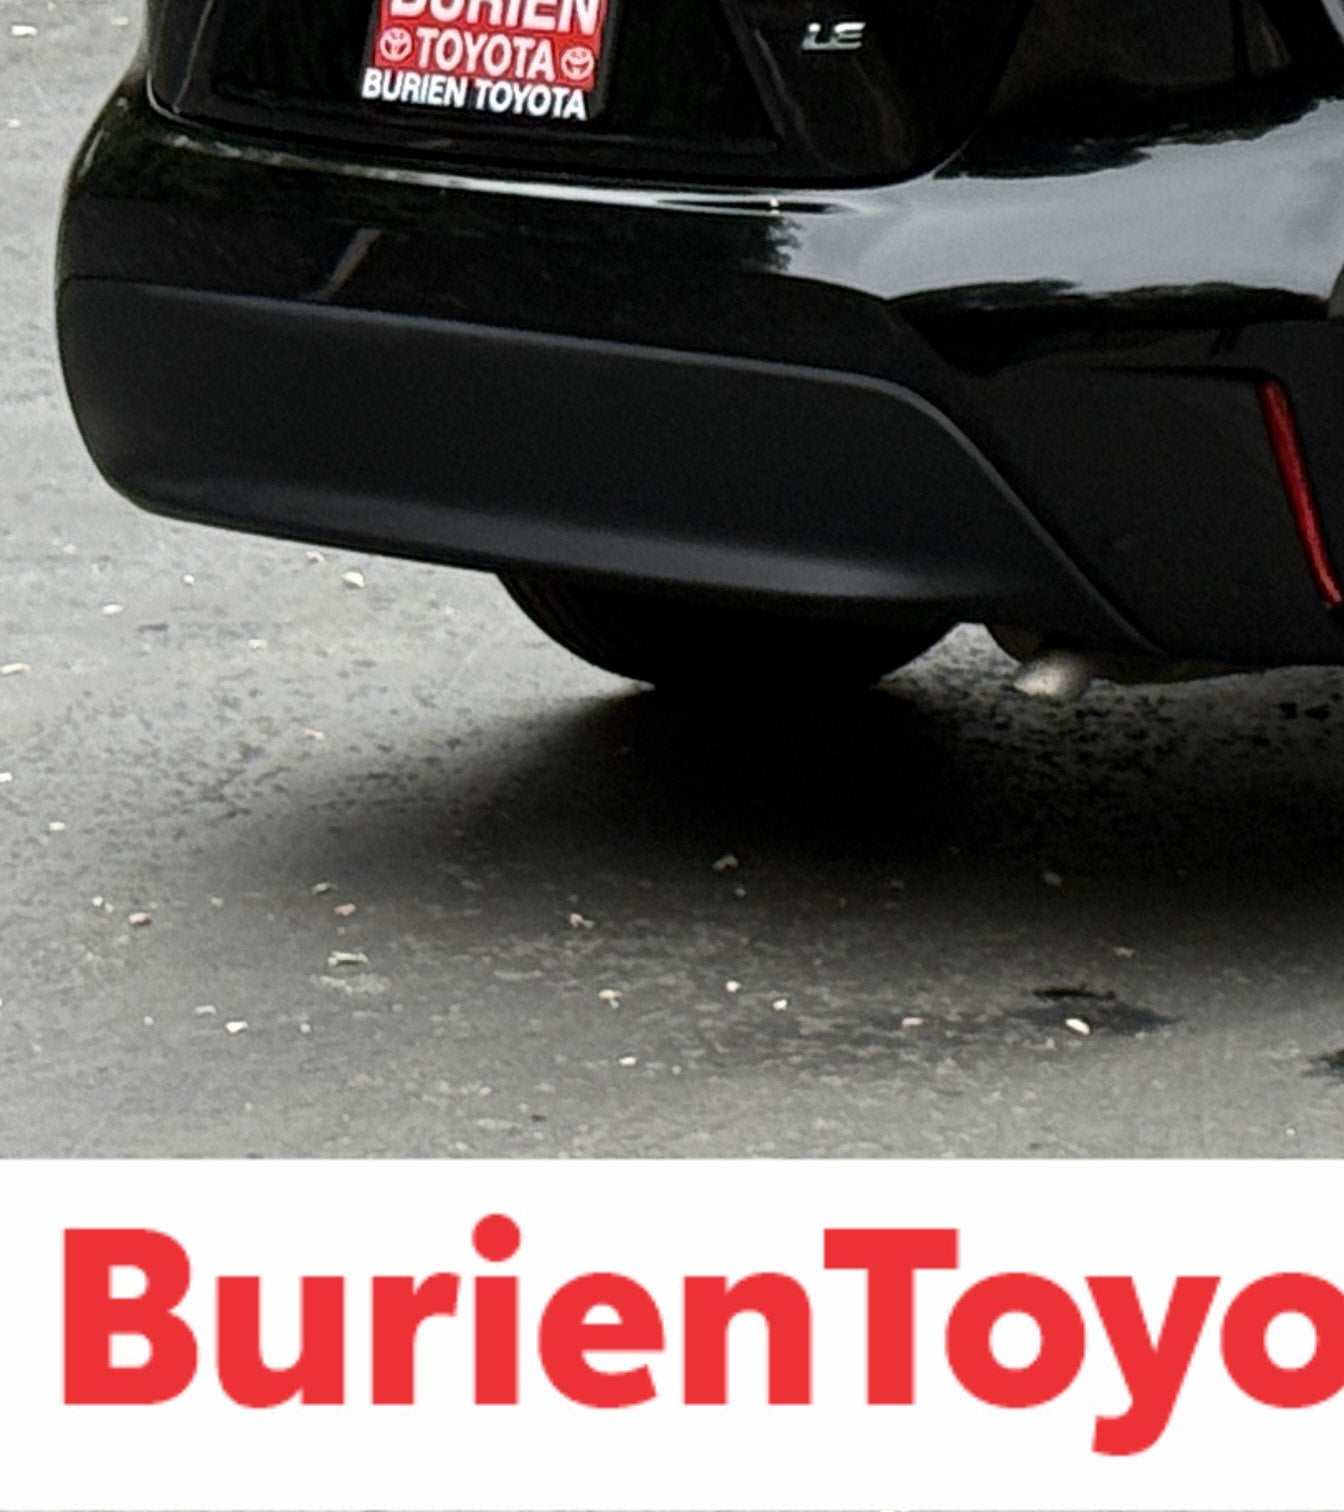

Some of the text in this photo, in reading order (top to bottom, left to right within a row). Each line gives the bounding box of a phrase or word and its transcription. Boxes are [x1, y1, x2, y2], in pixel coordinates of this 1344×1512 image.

[415, 26, 556, 82] TOYOTA
[802, 20, 867, 51] LE
[361, 67, 588, 122] BURIEN TOYOTA
